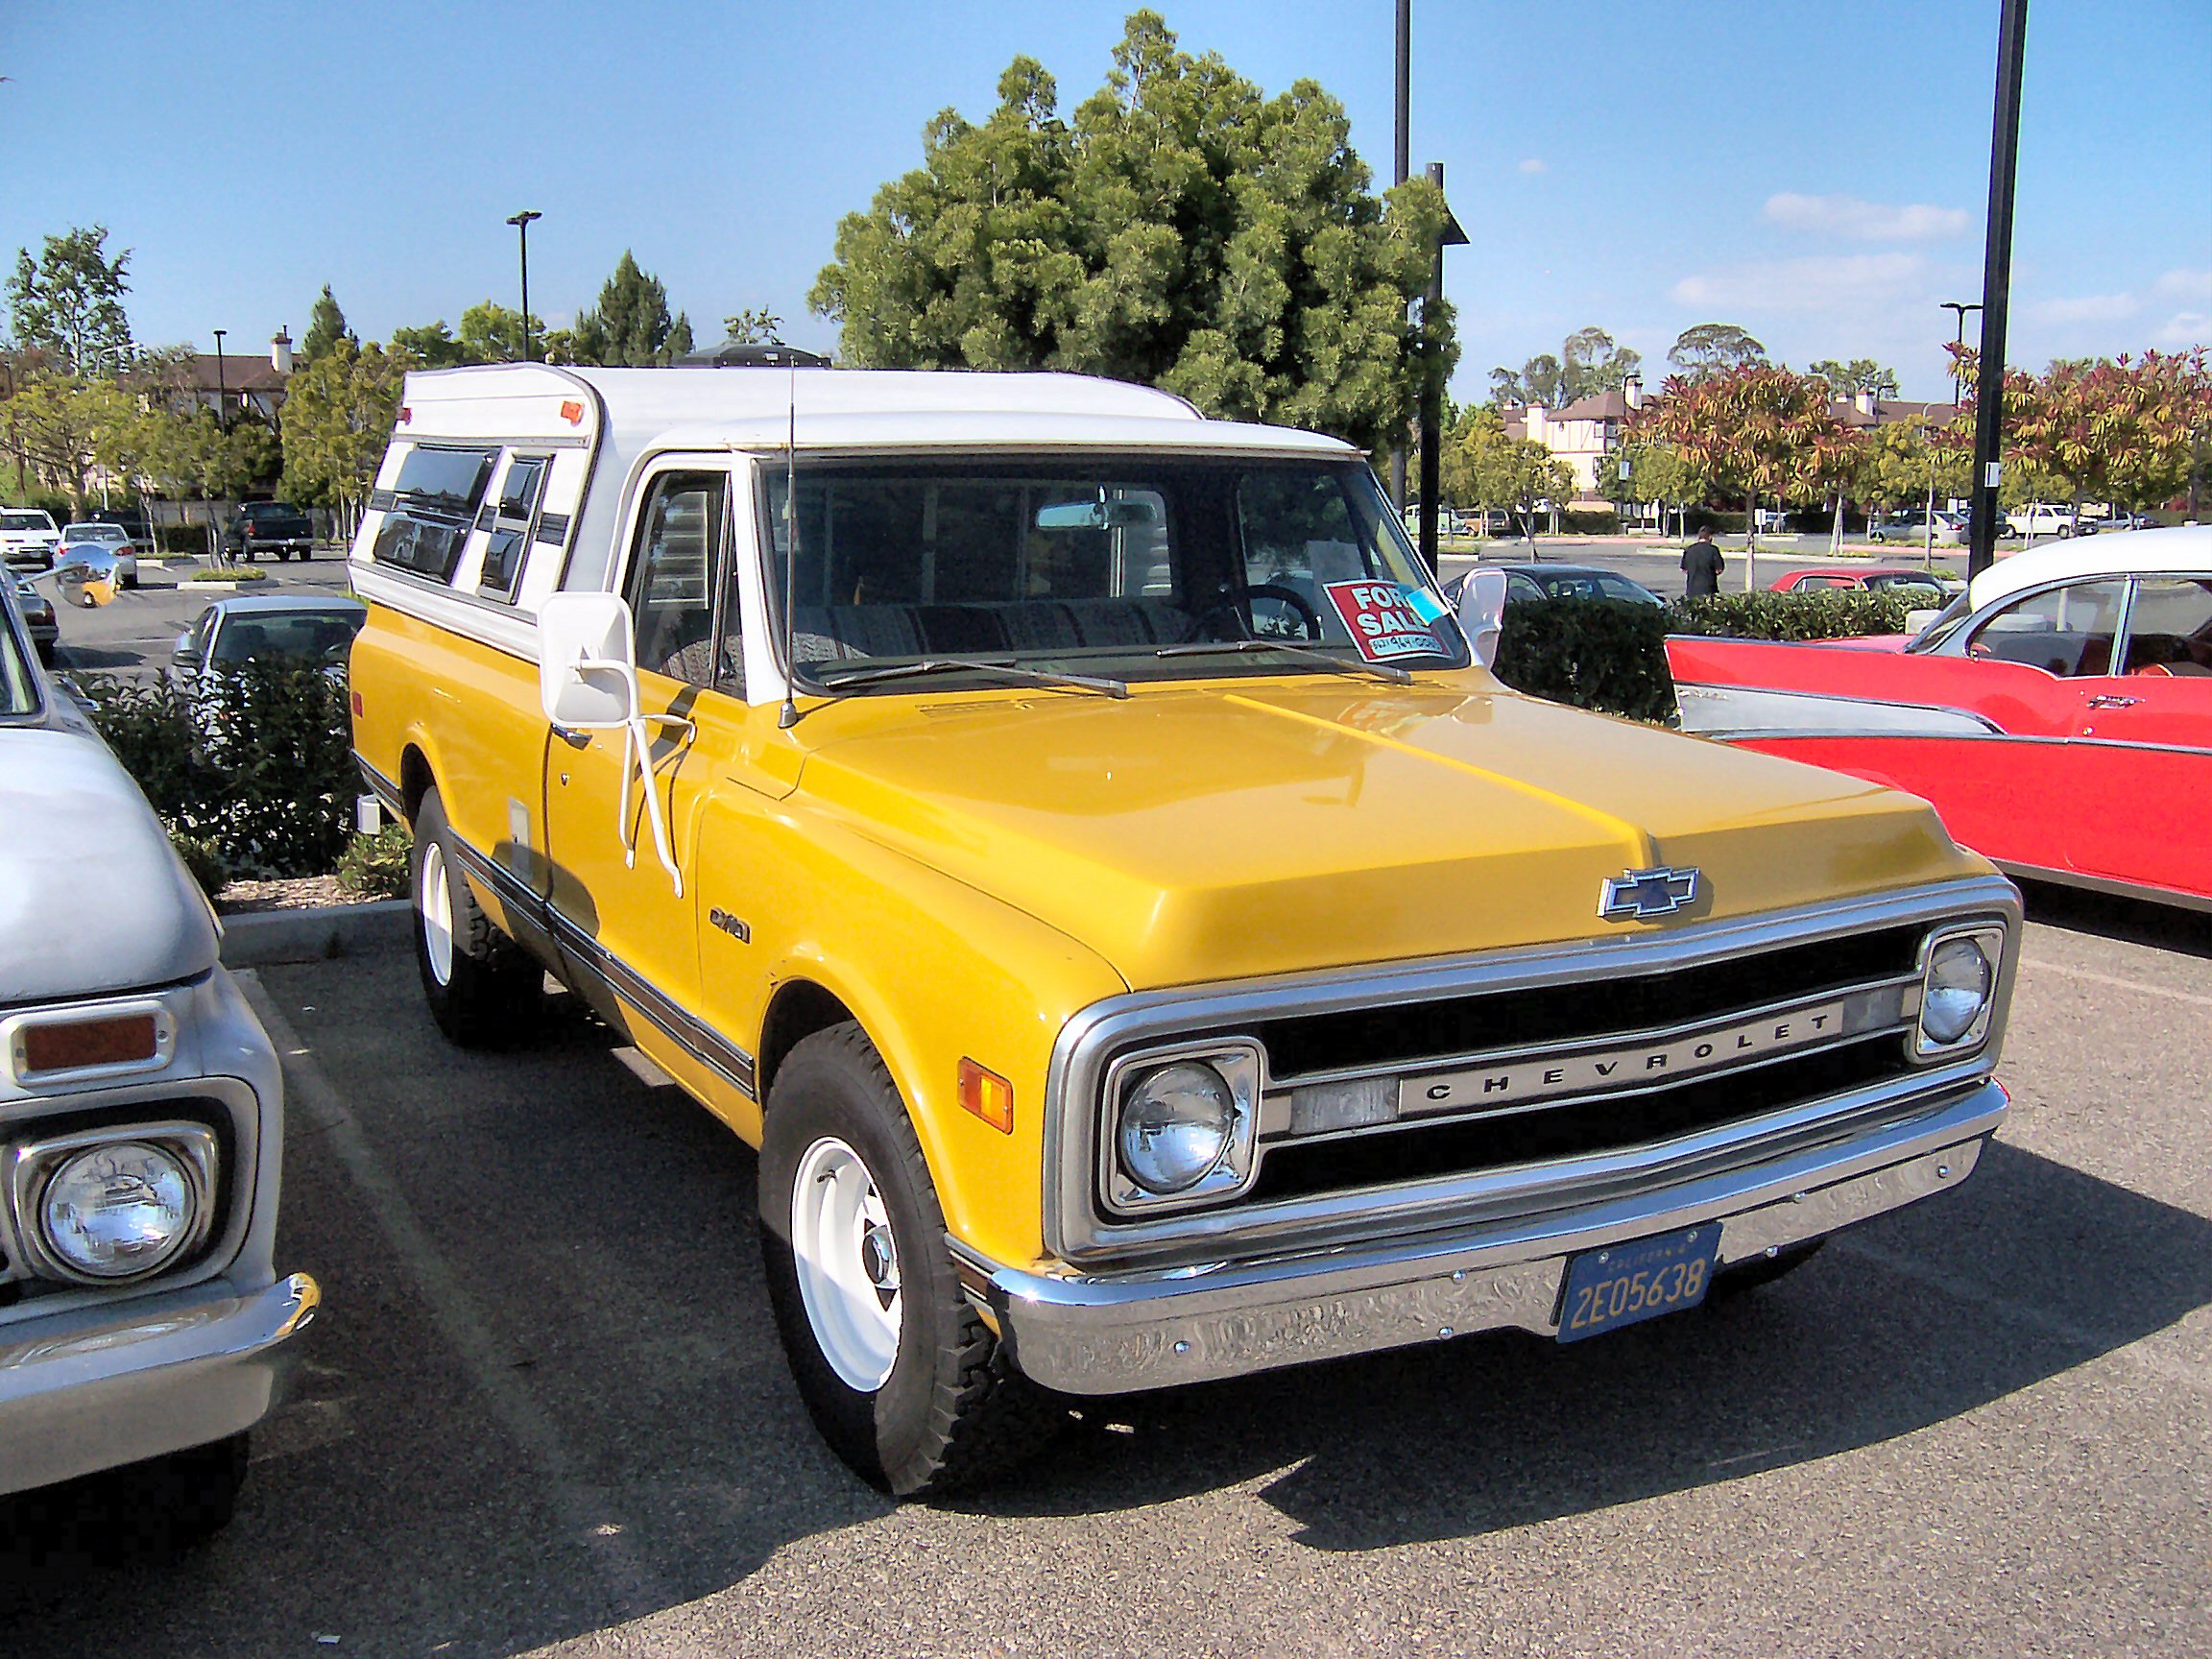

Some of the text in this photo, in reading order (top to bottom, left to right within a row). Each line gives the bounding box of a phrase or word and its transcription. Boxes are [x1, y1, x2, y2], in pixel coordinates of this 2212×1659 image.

[1351, 586, 1409, 611] FOR
[1426, 1014, 1828, 1100] CHEVROLET
[1570, 1258, 1706, 1330] 2E05638
